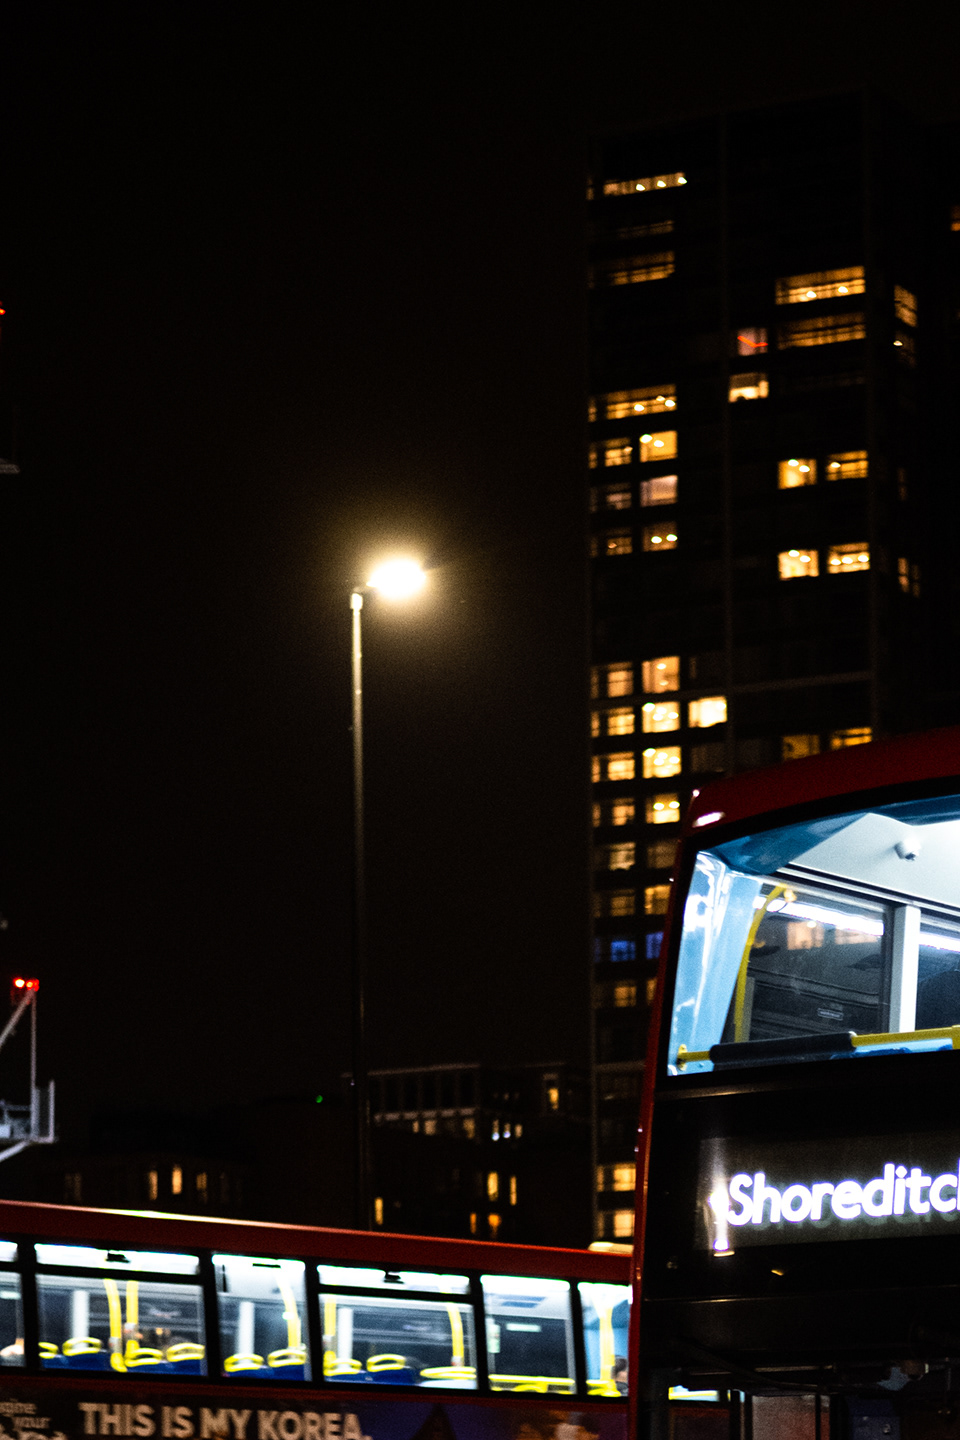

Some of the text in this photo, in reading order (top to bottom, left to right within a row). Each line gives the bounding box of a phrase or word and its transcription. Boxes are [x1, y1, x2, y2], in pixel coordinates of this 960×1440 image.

[79, 1402, 156, 1437] THIS
[162, 1406, 195, 1438] IS
[201, 1408, 250, 1440] MY
